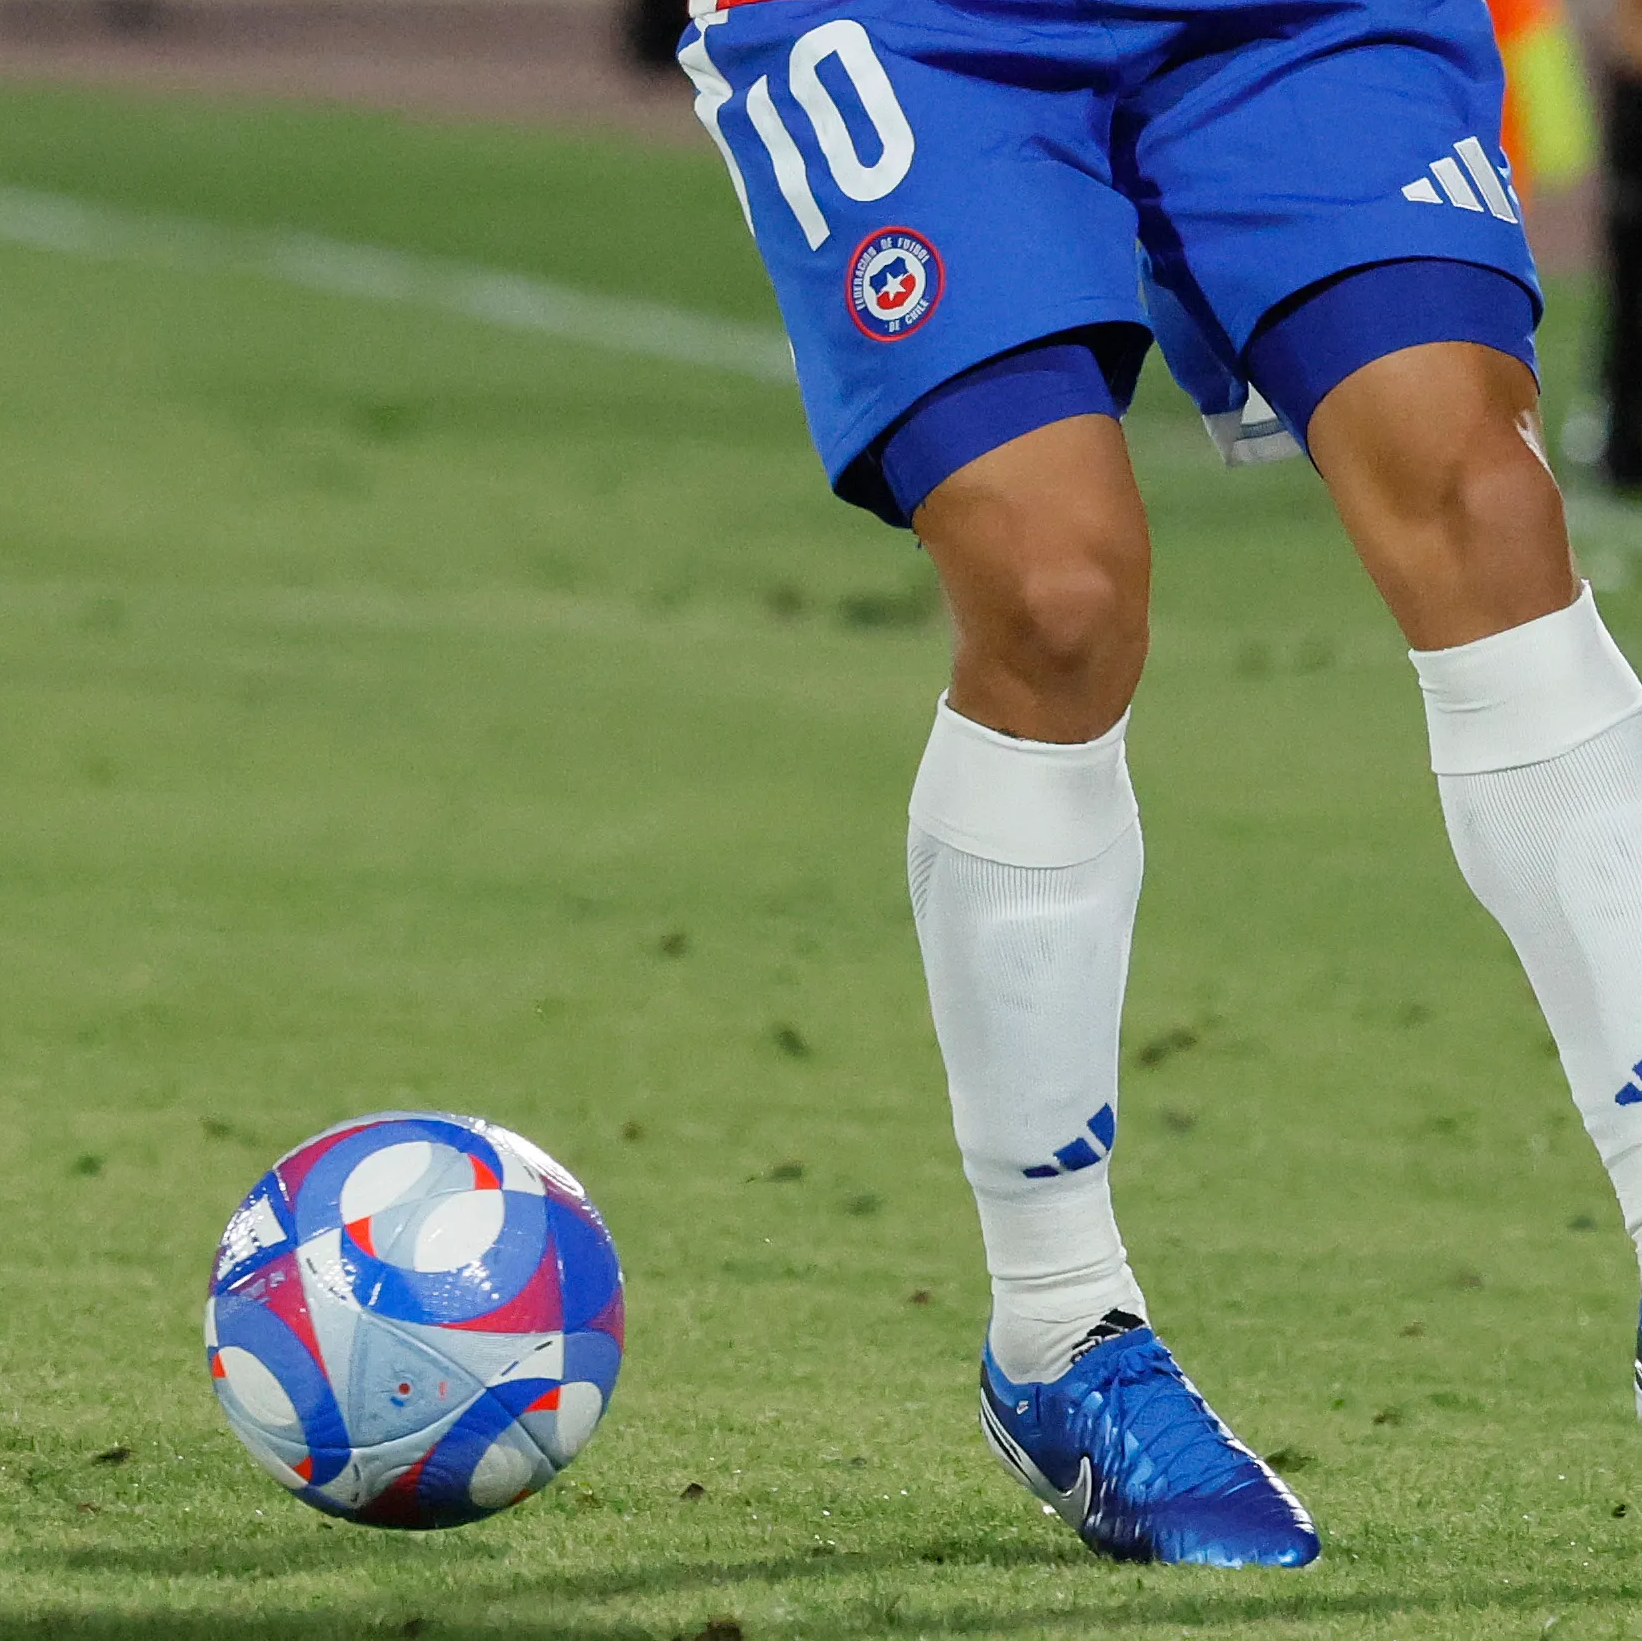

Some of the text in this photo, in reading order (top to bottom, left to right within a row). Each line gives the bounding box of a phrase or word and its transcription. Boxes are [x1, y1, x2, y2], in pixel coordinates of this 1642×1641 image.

[746, 19, 915, 252] 10
[889, 298, 930, 333] DE CHILE
